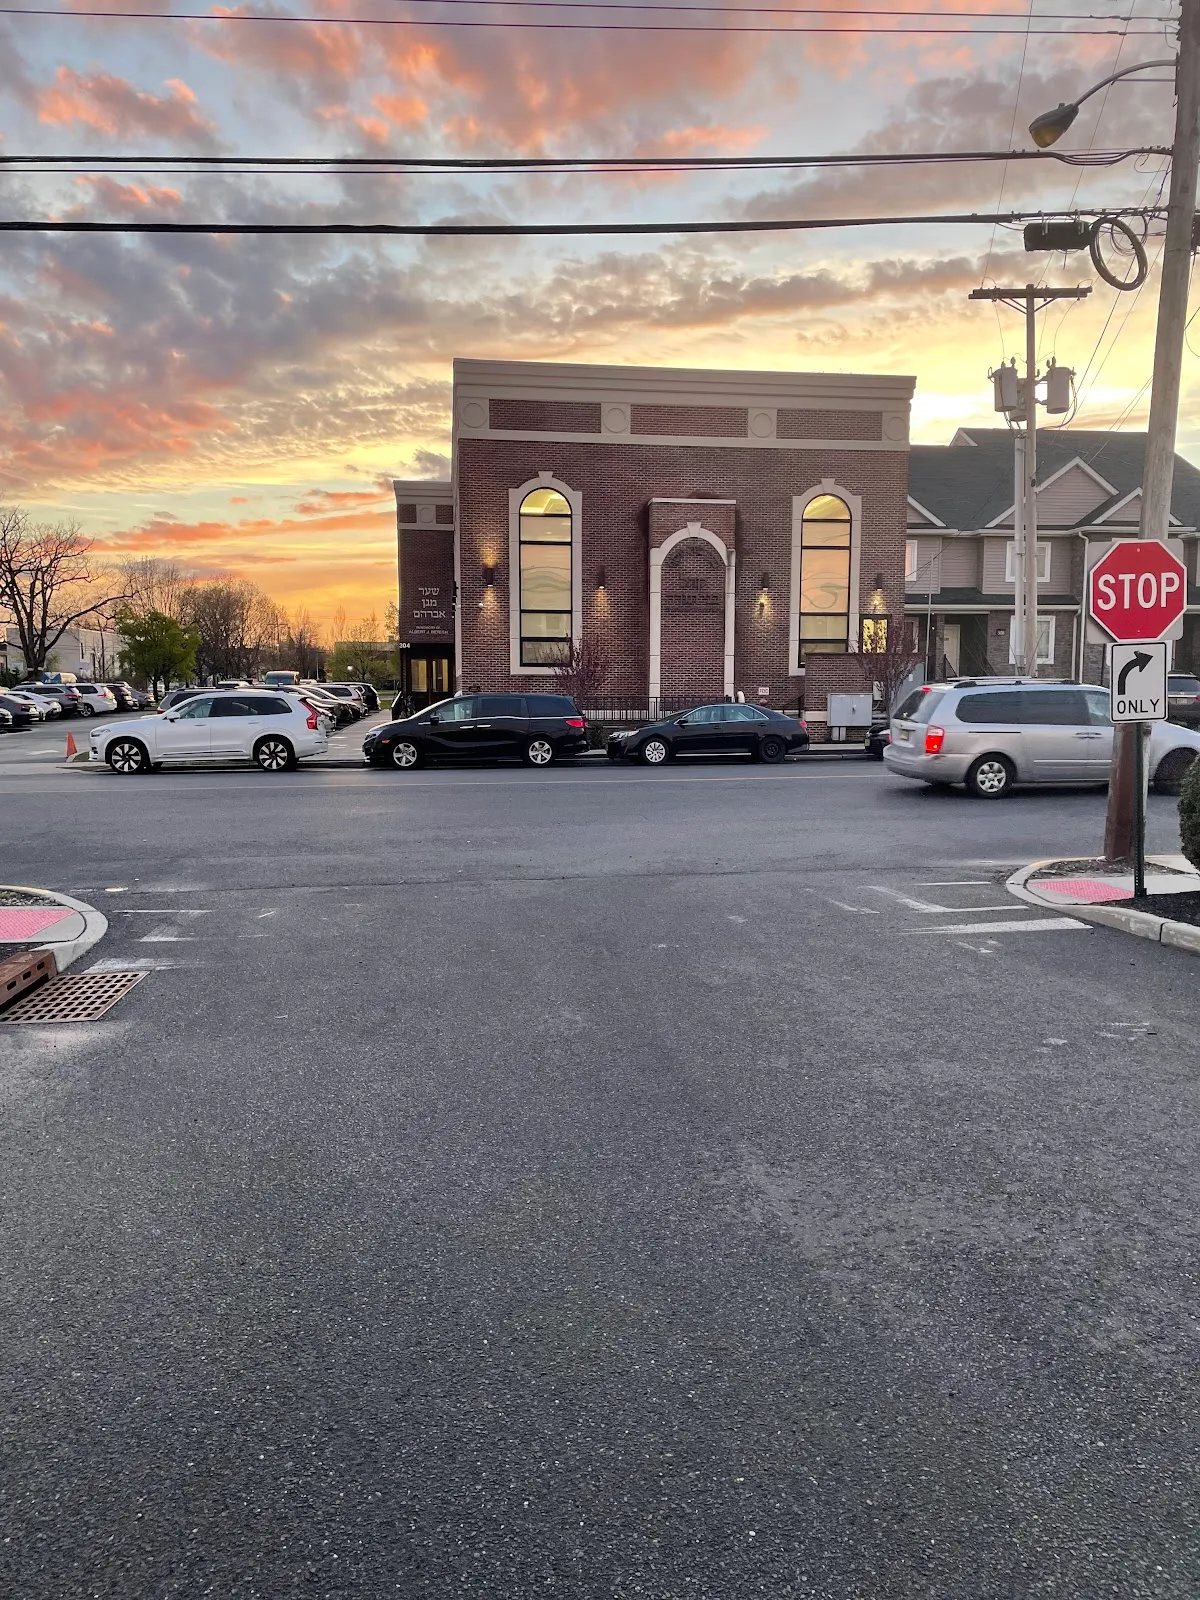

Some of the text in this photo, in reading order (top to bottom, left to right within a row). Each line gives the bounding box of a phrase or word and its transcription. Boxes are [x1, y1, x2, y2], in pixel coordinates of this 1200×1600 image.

[418, 587, 440, 596] שער
[1097, 572, 1180, 611] STOP
[421, 599, 437, 608] מגן
[413, 610, 446, 618] אברהם
[1116, 698, 1161, 714] ONLY
